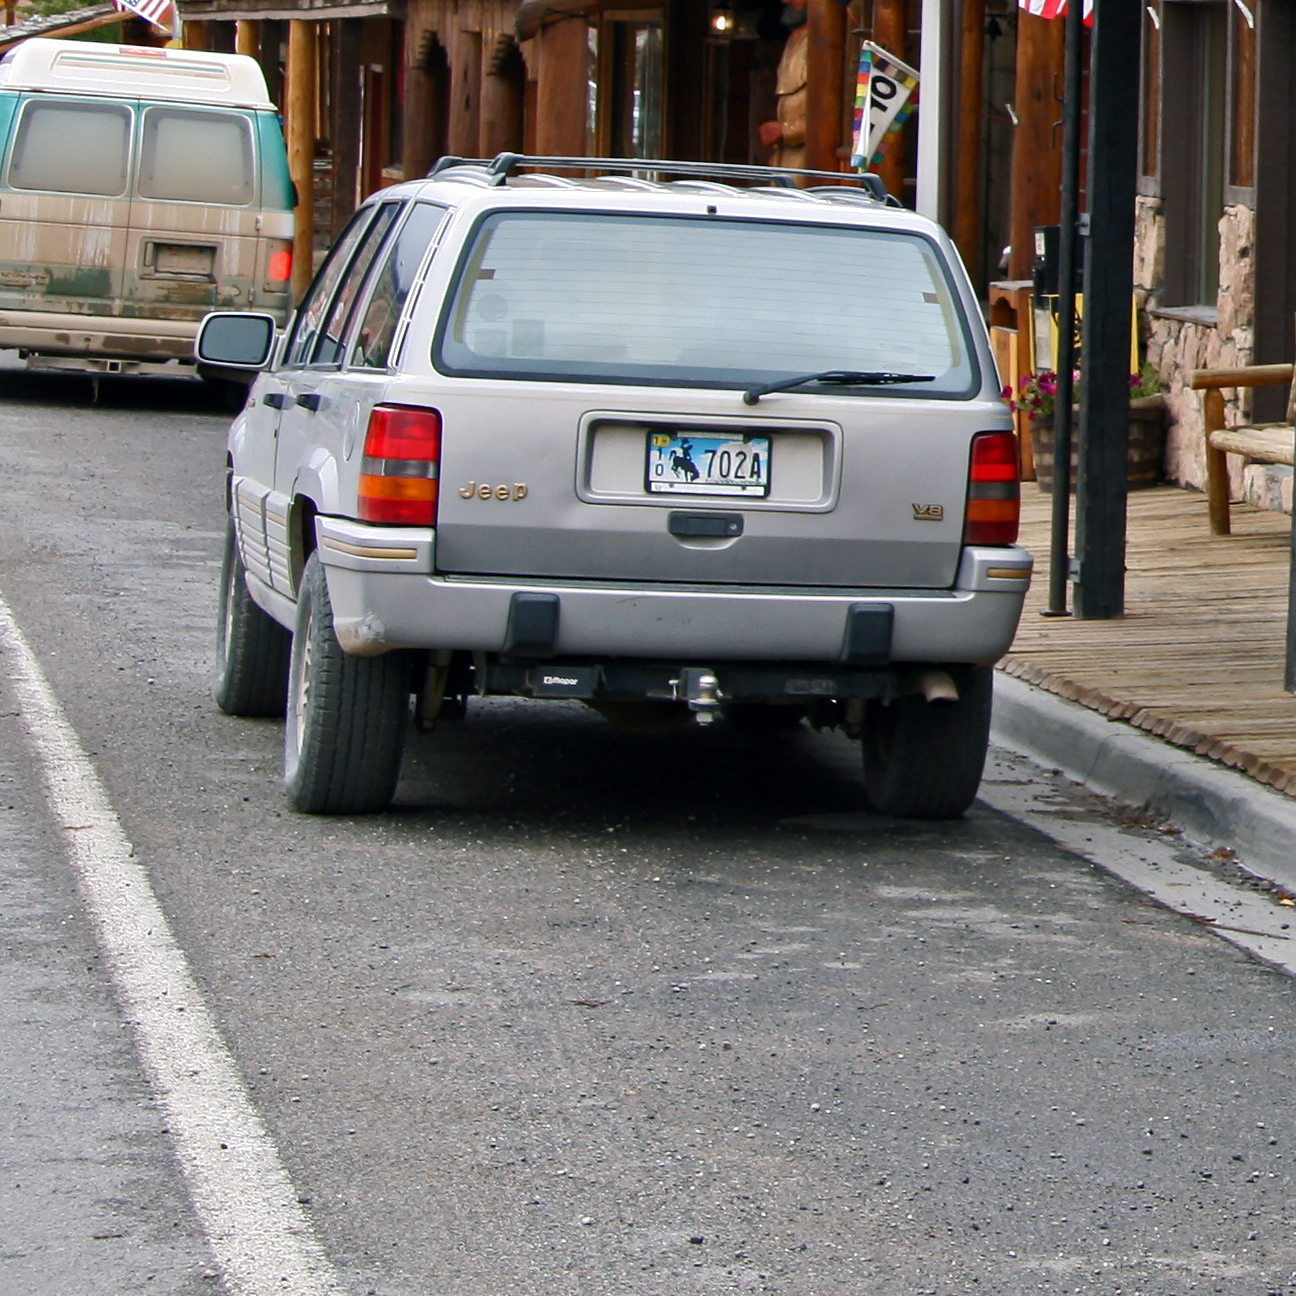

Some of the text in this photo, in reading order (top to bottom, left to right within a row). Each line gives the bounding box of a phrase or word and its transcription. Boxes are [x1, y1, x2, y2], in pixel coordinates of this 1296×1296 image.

[704, 449, 762, 480] 702A
[459, 480, 529, 502] Jeep
[911, 503, 944, 517] V8
